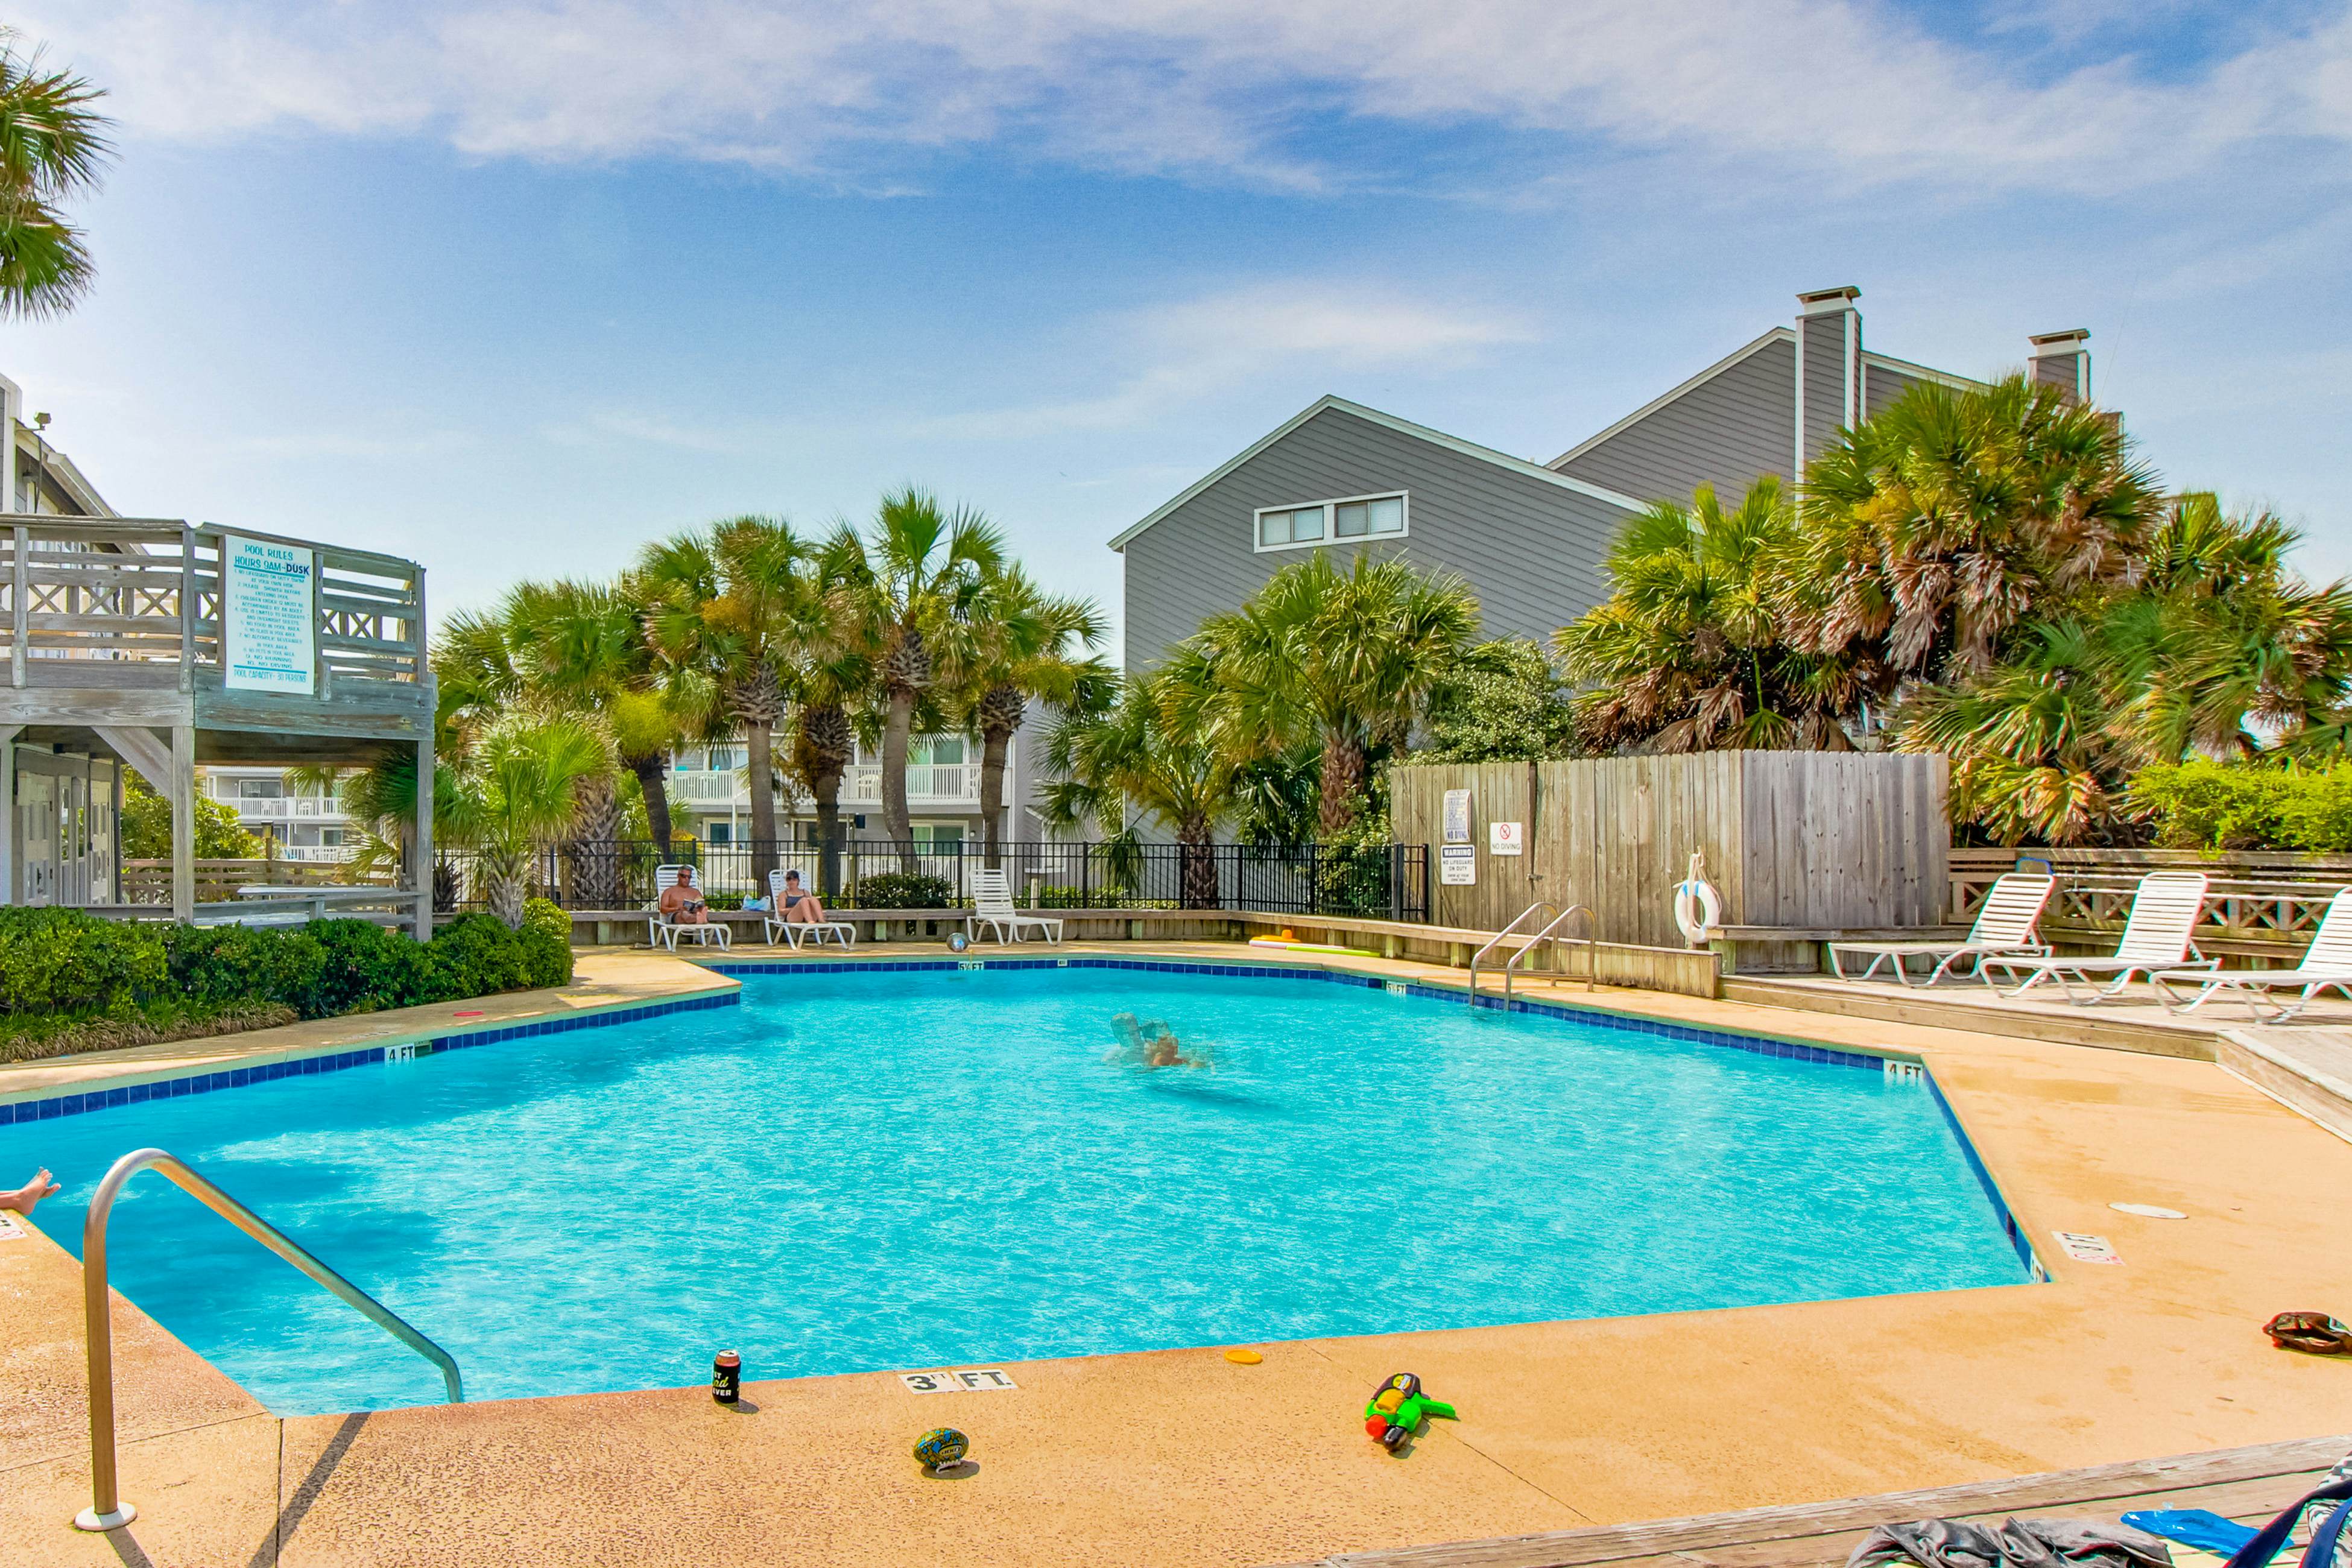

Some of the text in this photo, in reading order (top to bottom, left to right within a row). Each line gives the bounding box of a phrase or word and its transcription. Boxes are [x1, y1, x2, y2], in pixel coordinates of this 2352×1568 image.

[245, 545, 293, 560] POOL RULES
[235, 555, 261, 569] HOURS
[401, 1046, 414, 1060] FT
[1905, 1065, 1921, 1078] FT
[906, 1376, 938, 1390] 3
